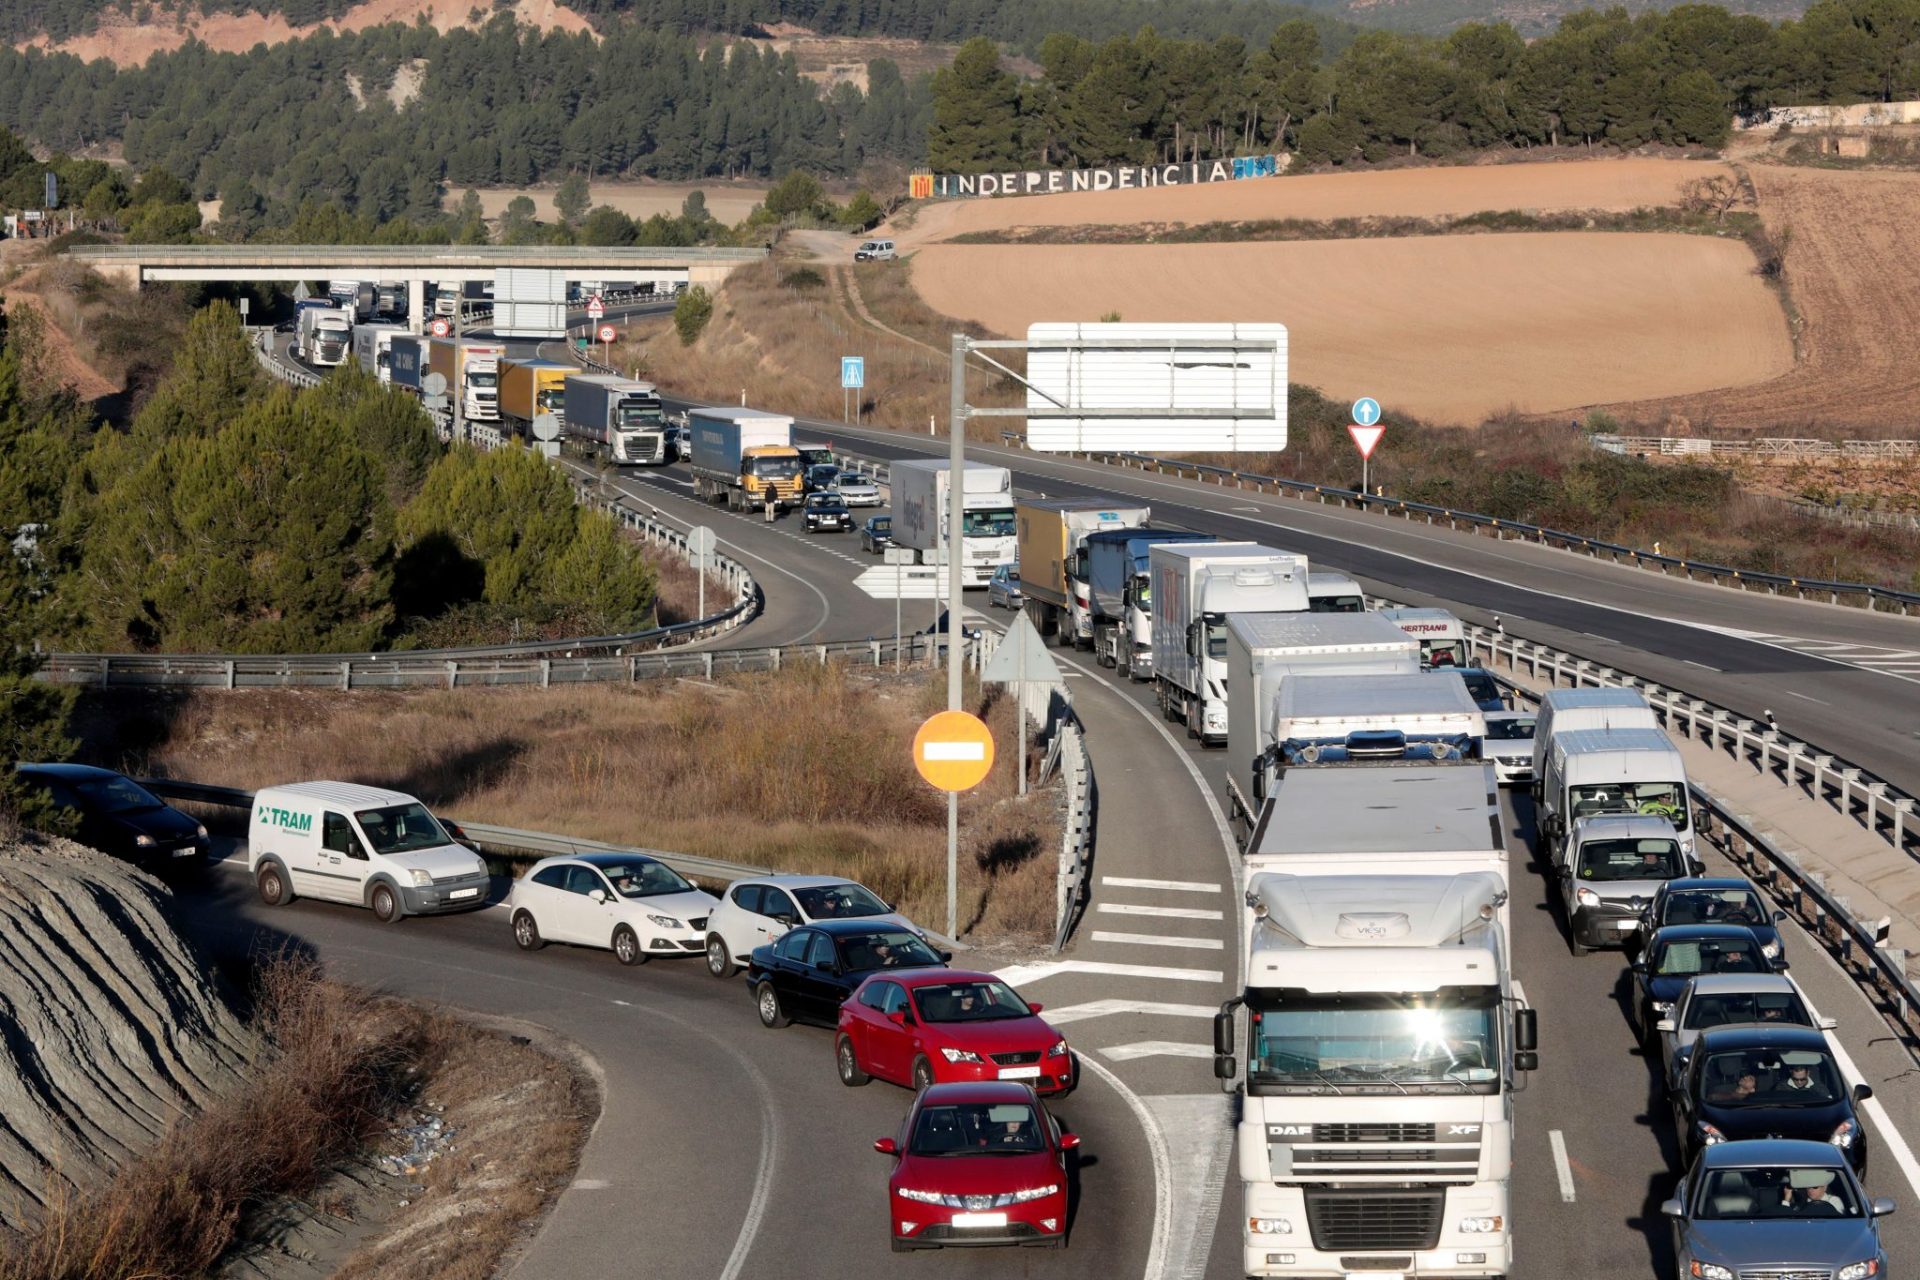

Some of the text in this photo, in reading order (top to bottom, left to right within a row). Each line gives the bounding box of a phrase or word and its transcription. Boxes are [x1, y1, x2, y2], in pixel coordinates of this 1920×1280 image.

[271, 807, 313, 831] TRAM
[1269, 1126, 1312, 1136] DAF
[1447, 1125, 1480, 1135] XF
